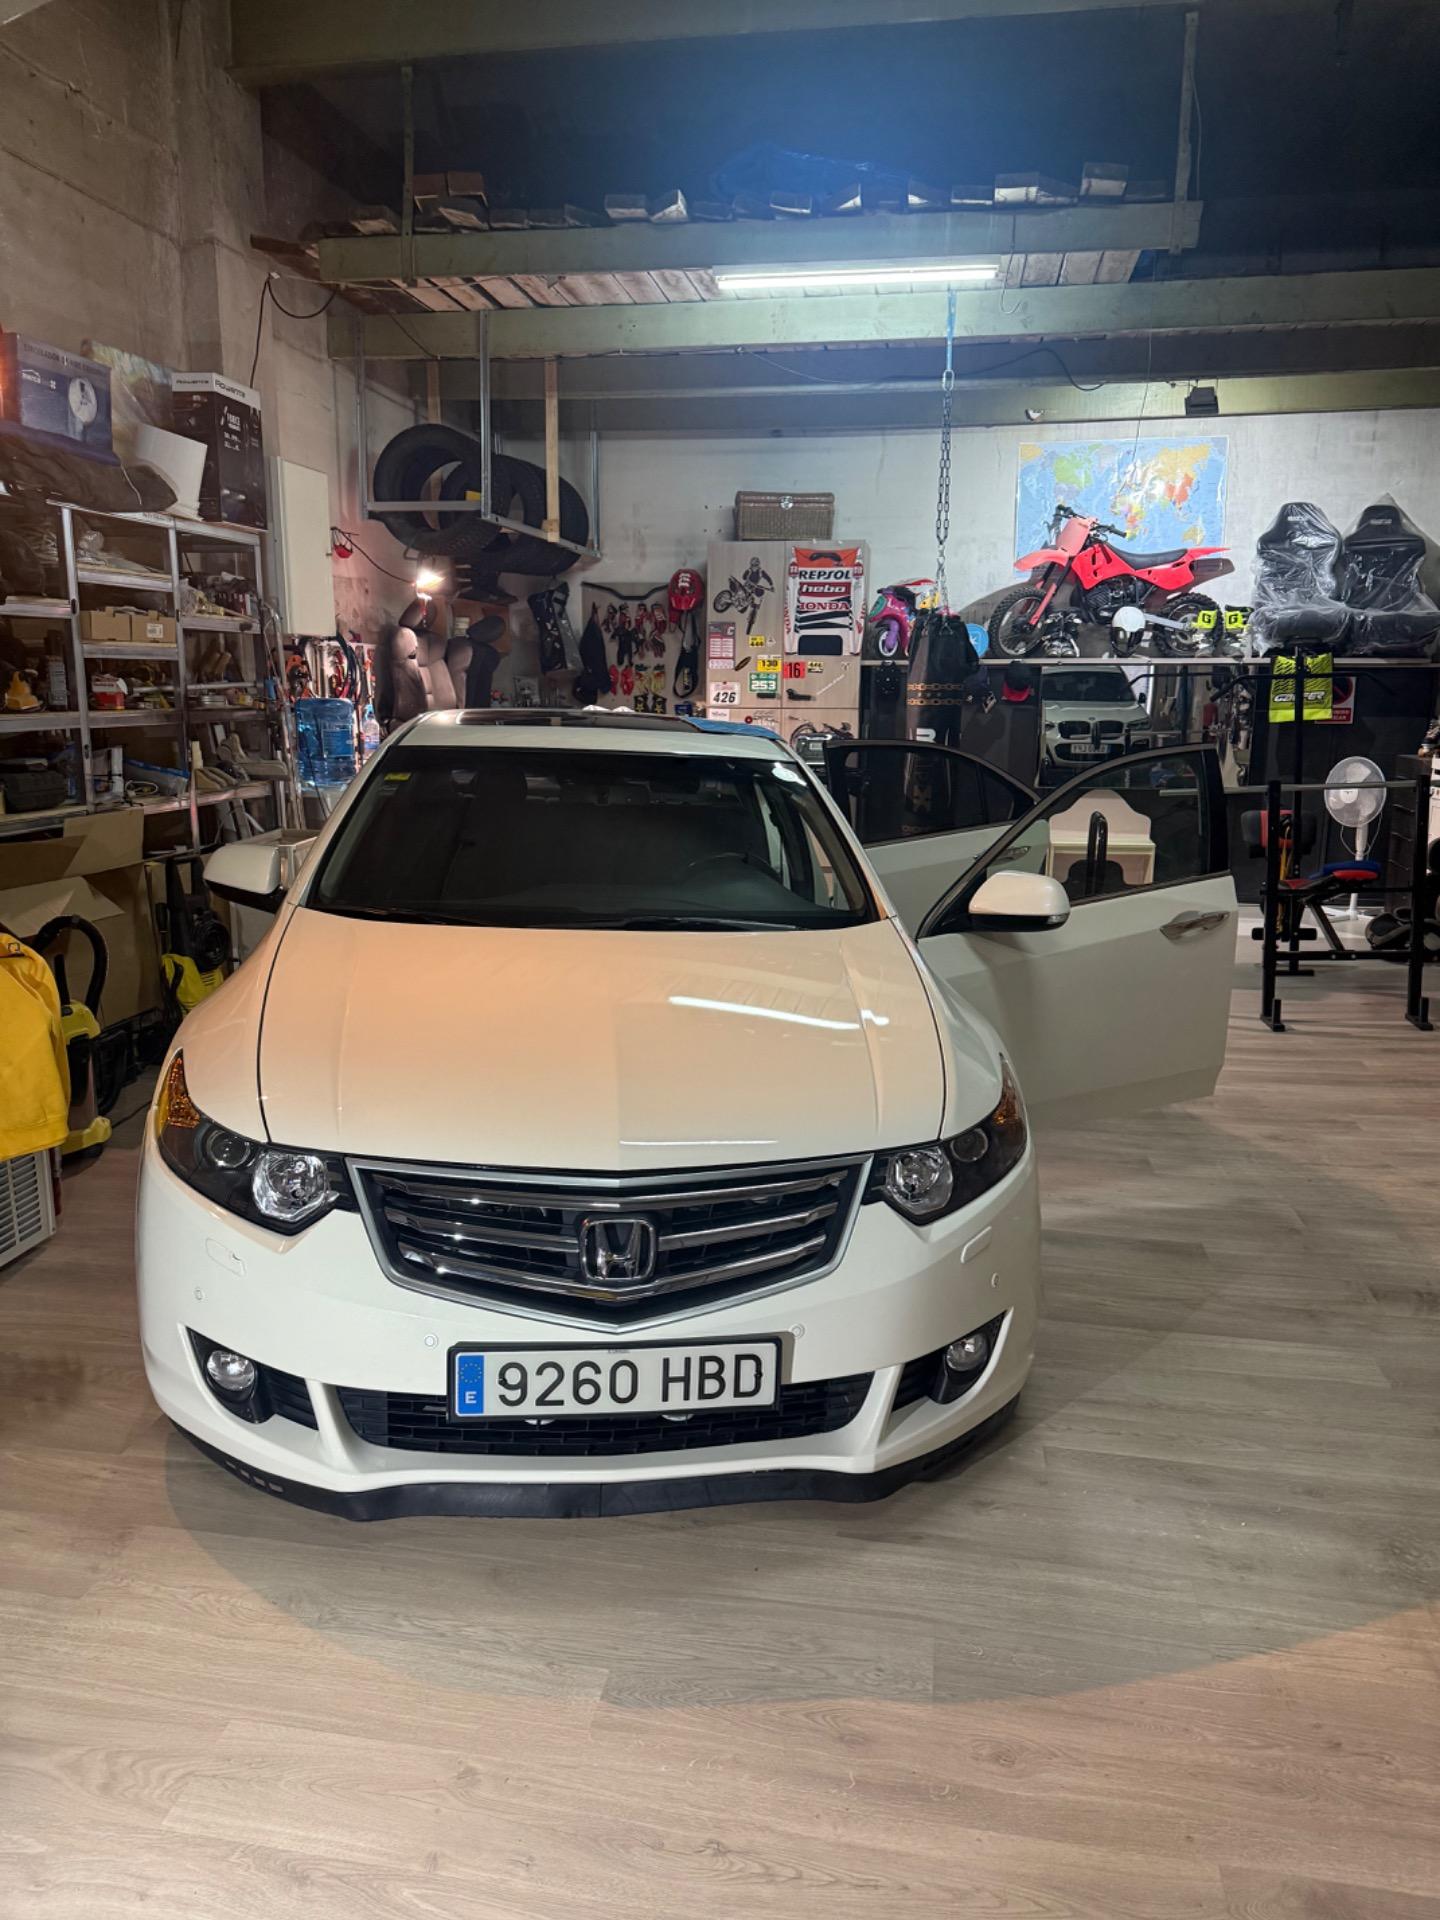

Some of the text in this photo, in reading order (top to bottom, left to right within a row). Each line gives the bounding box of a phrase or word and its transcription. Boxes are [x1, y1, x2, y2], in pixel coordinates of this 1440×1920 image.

[798, 569, 852, 580] REPSOL
[802, 584, 846, 593] hebo
[788, 662, 801, 679] 16
[751, 680, 777, 690] 253
[713, 692, 736, 703] 426
[498, 1354, 763, 1407] 9260 HBD
[465, 1391, 477, 1404] E
